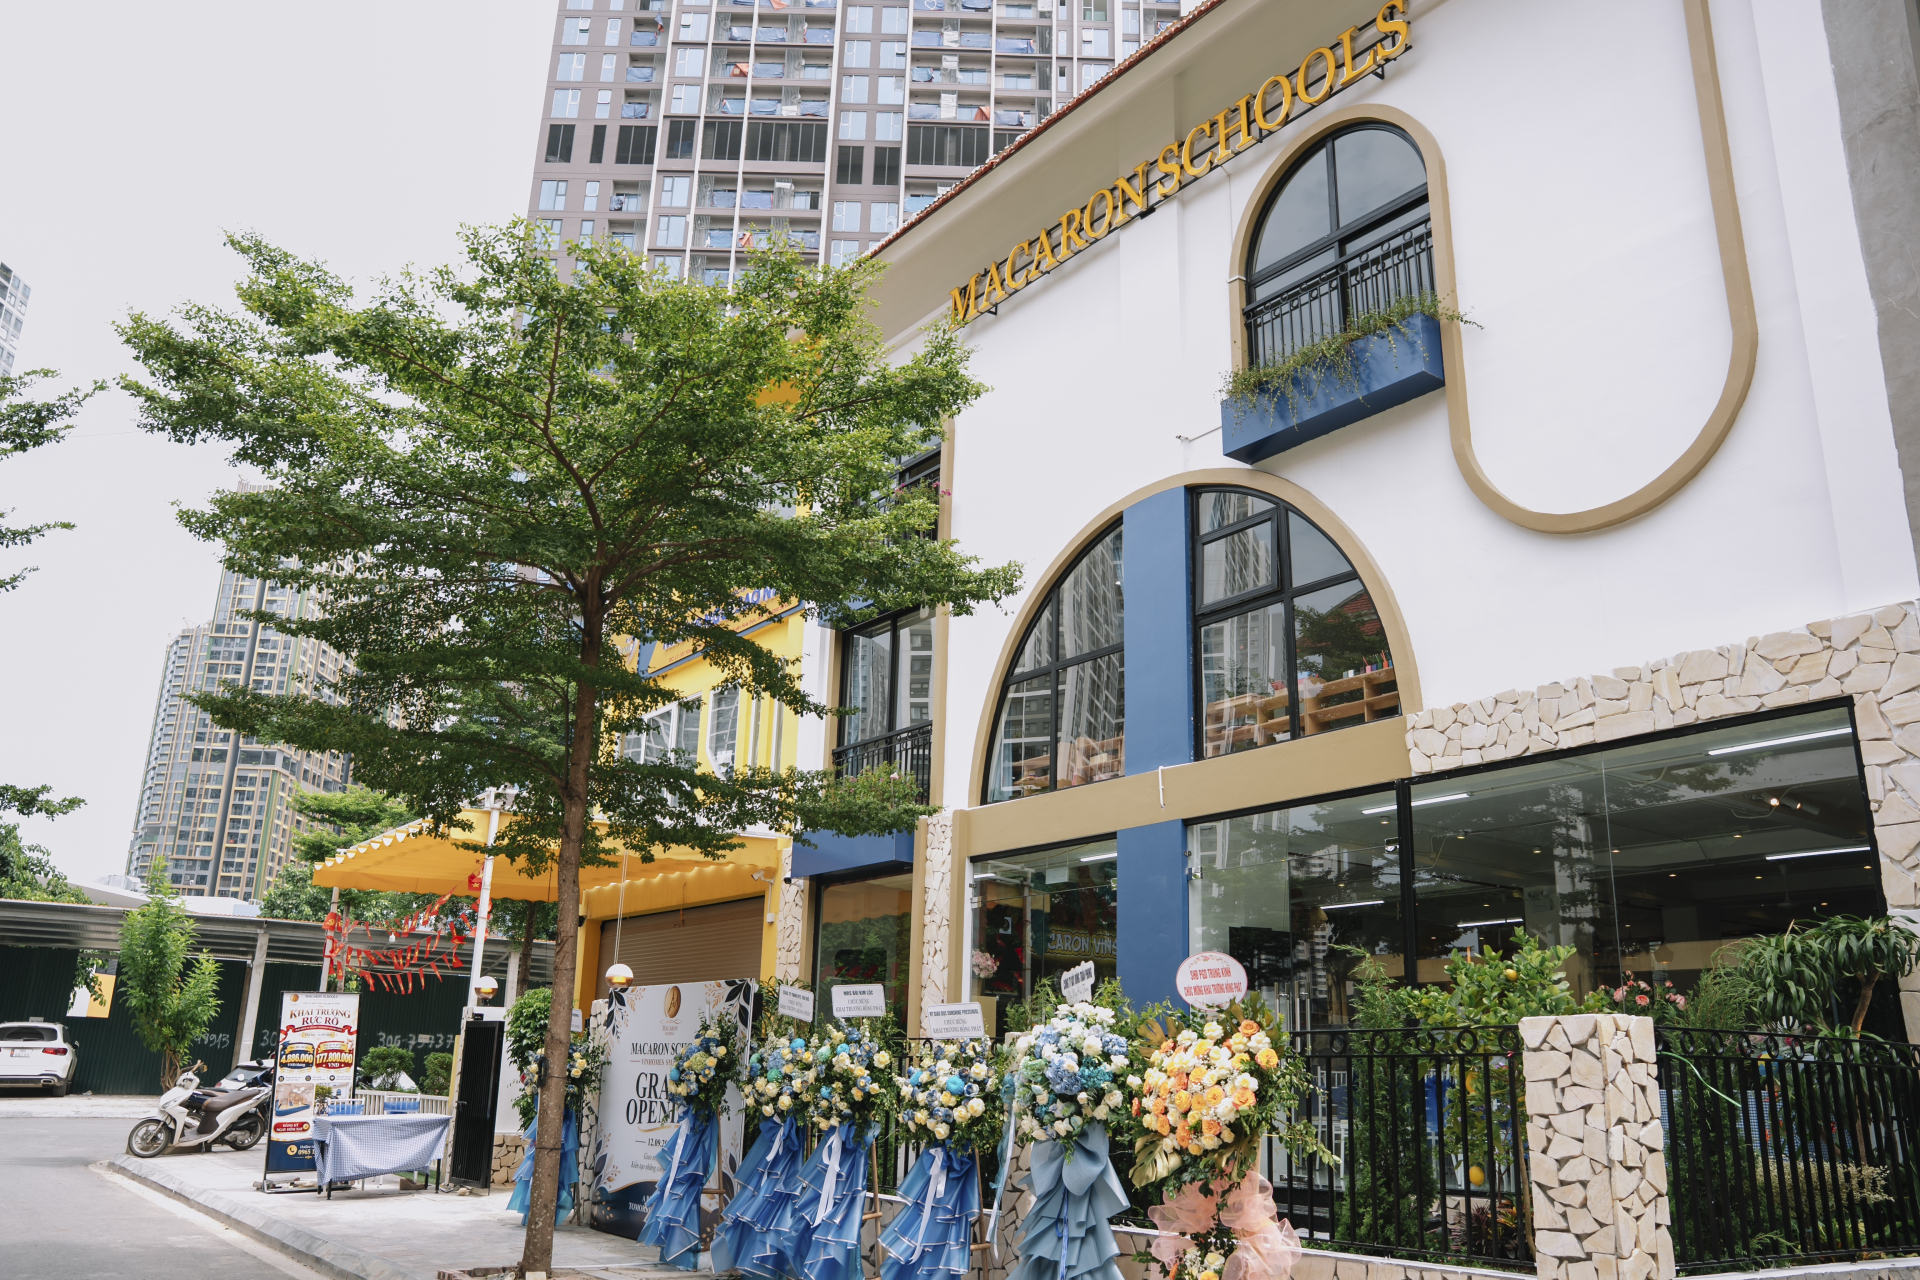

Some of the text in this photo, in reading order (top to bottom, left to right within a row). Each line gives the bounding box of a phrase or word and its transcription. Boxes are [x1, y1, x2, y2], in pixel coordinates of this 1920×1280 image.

[948, 0, 1411, 331] MACARON SCHOOLS
[1207, 968, 1221, 978] TRUNG
[289, 1009, 314, 1019] KHAI
[631, 1042, 670, 1055] MACARON
[316, 1052, 353, 1064] 177.800.000
